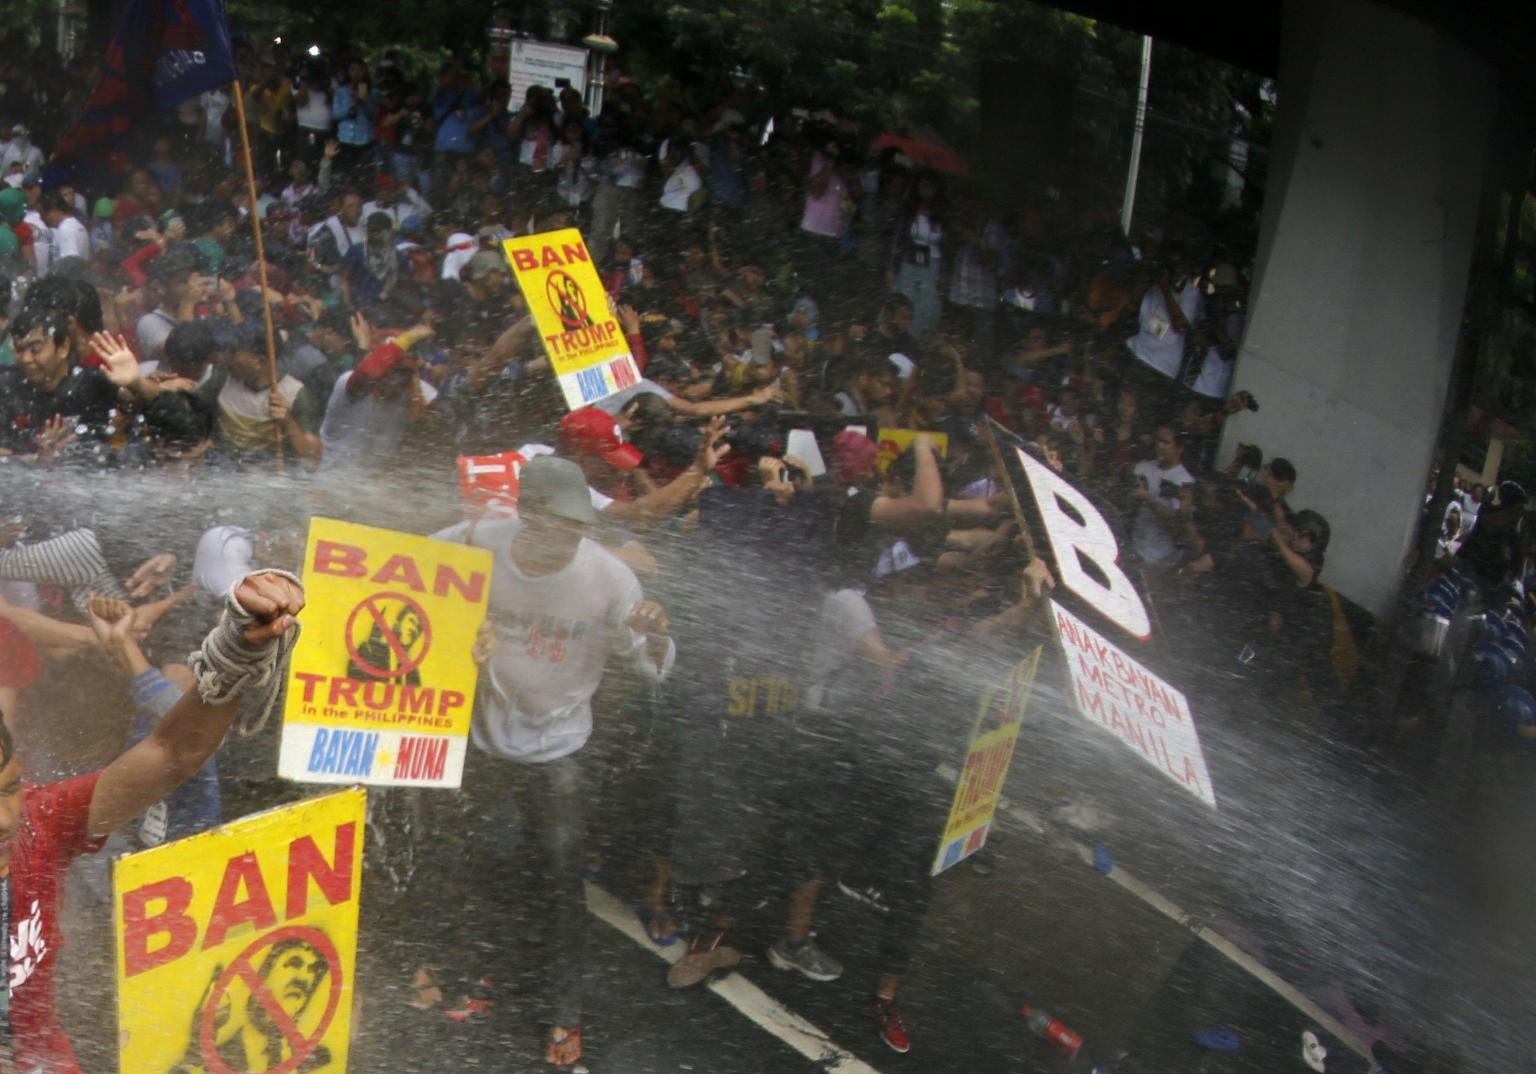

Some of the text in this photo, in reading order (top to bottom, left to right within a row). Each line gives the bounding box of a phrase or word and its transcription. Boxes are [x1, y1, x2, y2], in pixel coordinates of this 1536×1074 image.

[511, 241, 589, 271] BAN
[545, 320, 617, 354] TRUMP
[312, 539, 486, 603] BAN
[1016, 447, 1154, 641] B
[295, 672, 464, 717] TRUMP
[1057, 610, 1181, 722] ANAKBAYAN
[1079, 653, 1165, 728] METRO
[302, 705, 454, 729] in the PHILIPPINES
[1076, 676, 1206, 795] MANILA
[307, 728, 450, 781] BAYAN MUNA
[122, 821, 356, 979] BAN
